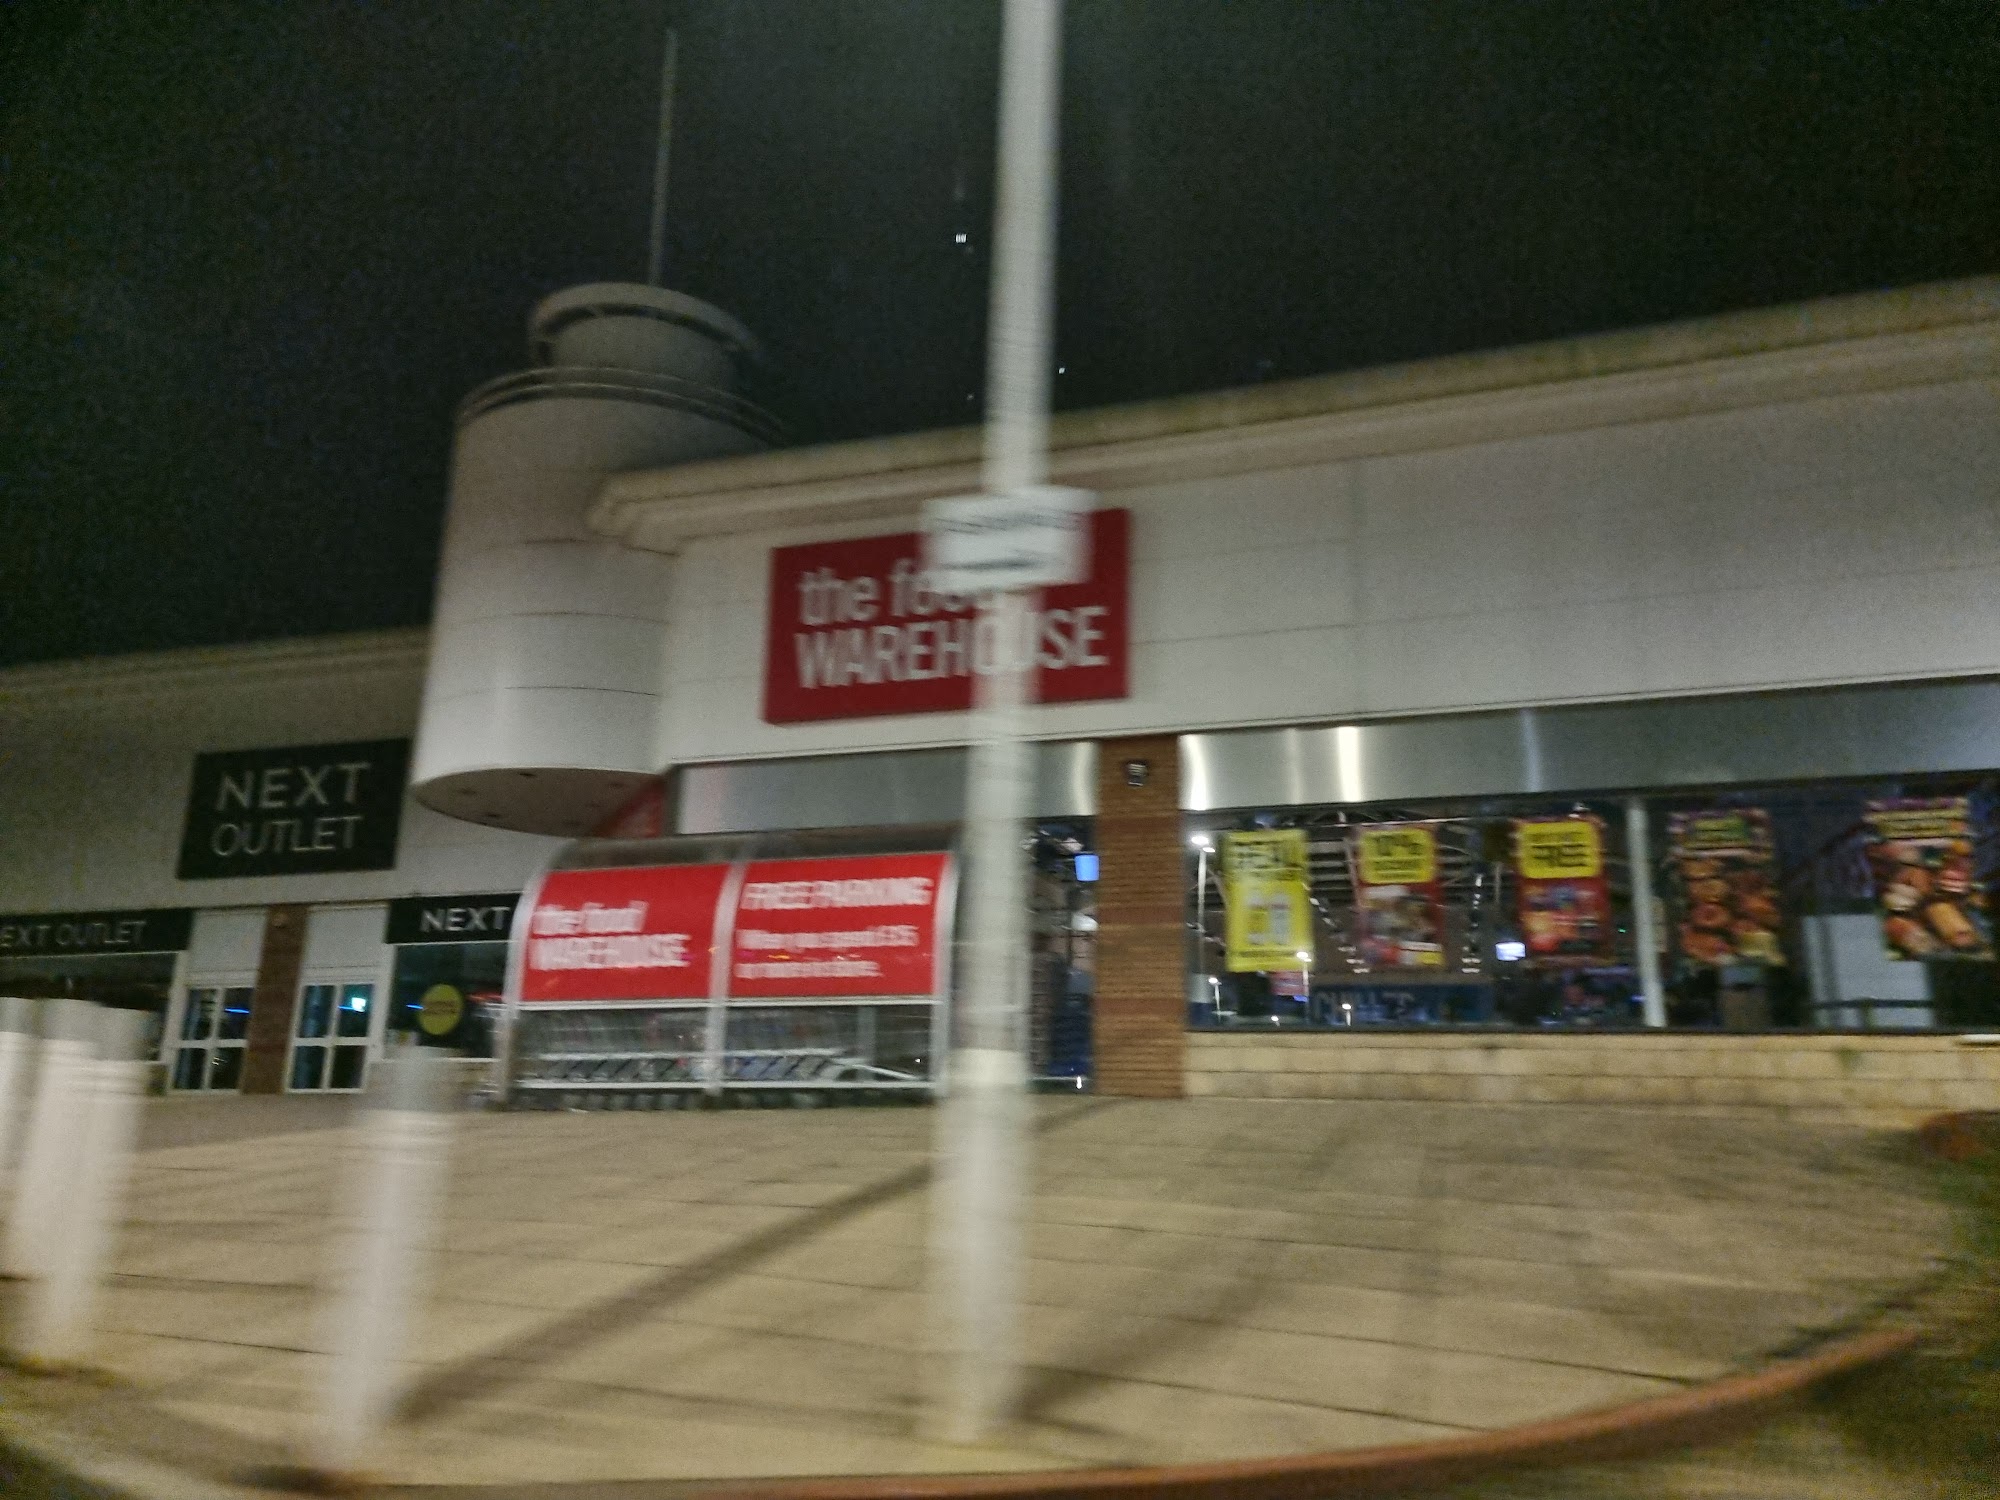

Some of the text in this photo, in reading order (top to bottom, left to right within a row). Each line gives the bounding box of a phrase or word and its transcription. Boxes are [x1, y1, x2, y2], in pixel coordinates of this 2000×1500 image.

[798, 567, 880, 626] the
[216, 761, 371, 811] NEXT
[211, 815, 364, 857] OUTLET
[0, 920, 147, 948] EXT OUTLET
[421, 906, 511, 933] NEXT
